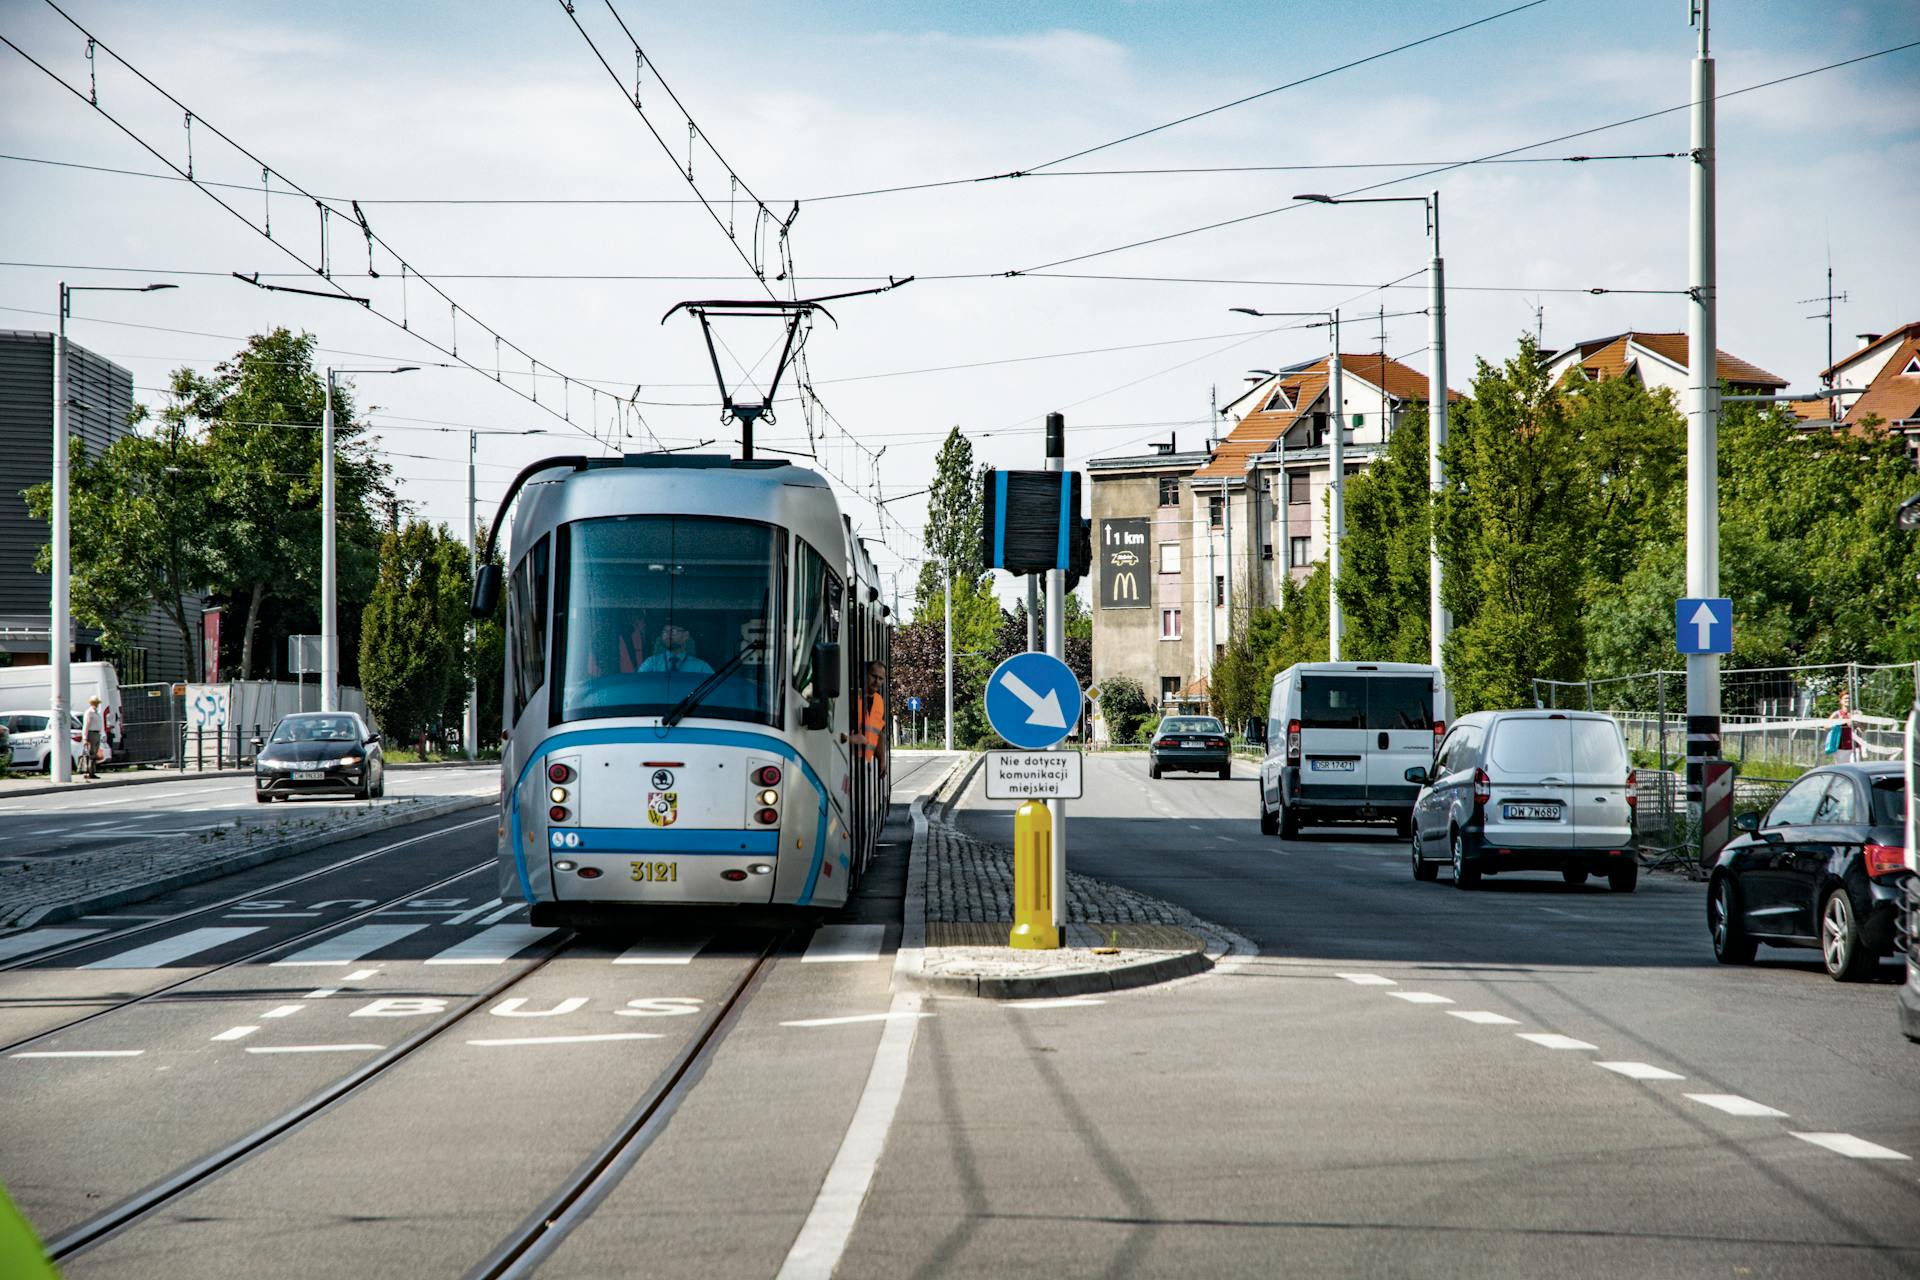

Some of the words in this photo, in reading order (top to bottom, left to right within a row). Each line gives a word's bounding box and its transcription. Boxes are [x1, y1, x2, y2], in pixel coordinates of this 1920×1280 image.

[1113, 532, 1120, 545] 1
[1124, 531, 1145, 545] km
[1000, 756, 1020, 766] Nie
[1024, 756, 1067, 768] dotyczy
[999, 769, 1068, 781] komunikacji
[1009, 782, 1059, 795] miejskiej
[1510, 807, 1525, 817] DW
[630, 861, 677, 882] 3121
[229, 898, 470, 910] BUS
[349, 997, 704, 1017] BUS
